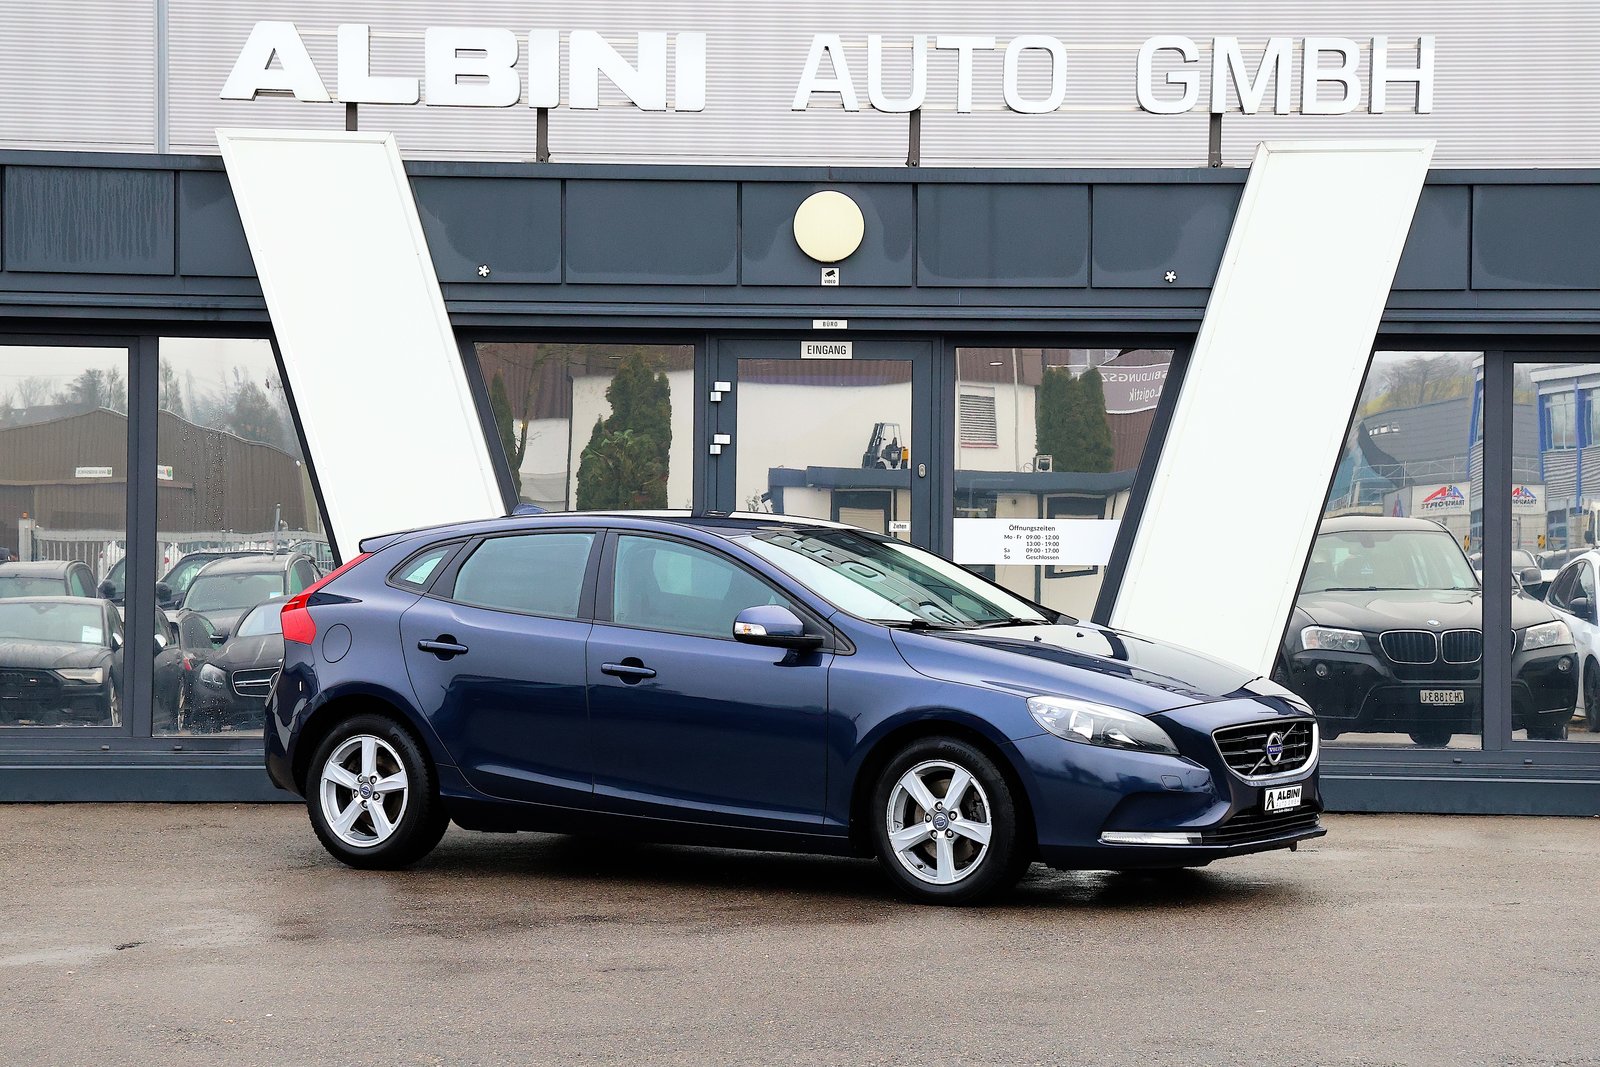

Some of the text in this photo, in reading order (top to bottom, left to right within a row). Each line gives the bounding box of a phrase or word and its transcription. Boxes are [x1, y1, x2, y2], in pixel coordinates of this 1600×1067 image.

[219, 20, 1436, 115] ALBINI AUTO GMBH
[807, 345, 847, 355] EINGANG
[1009, 524, 1055, 532] Öffnungszeiten
[1277, 788, 1300, 801] ALBINI
